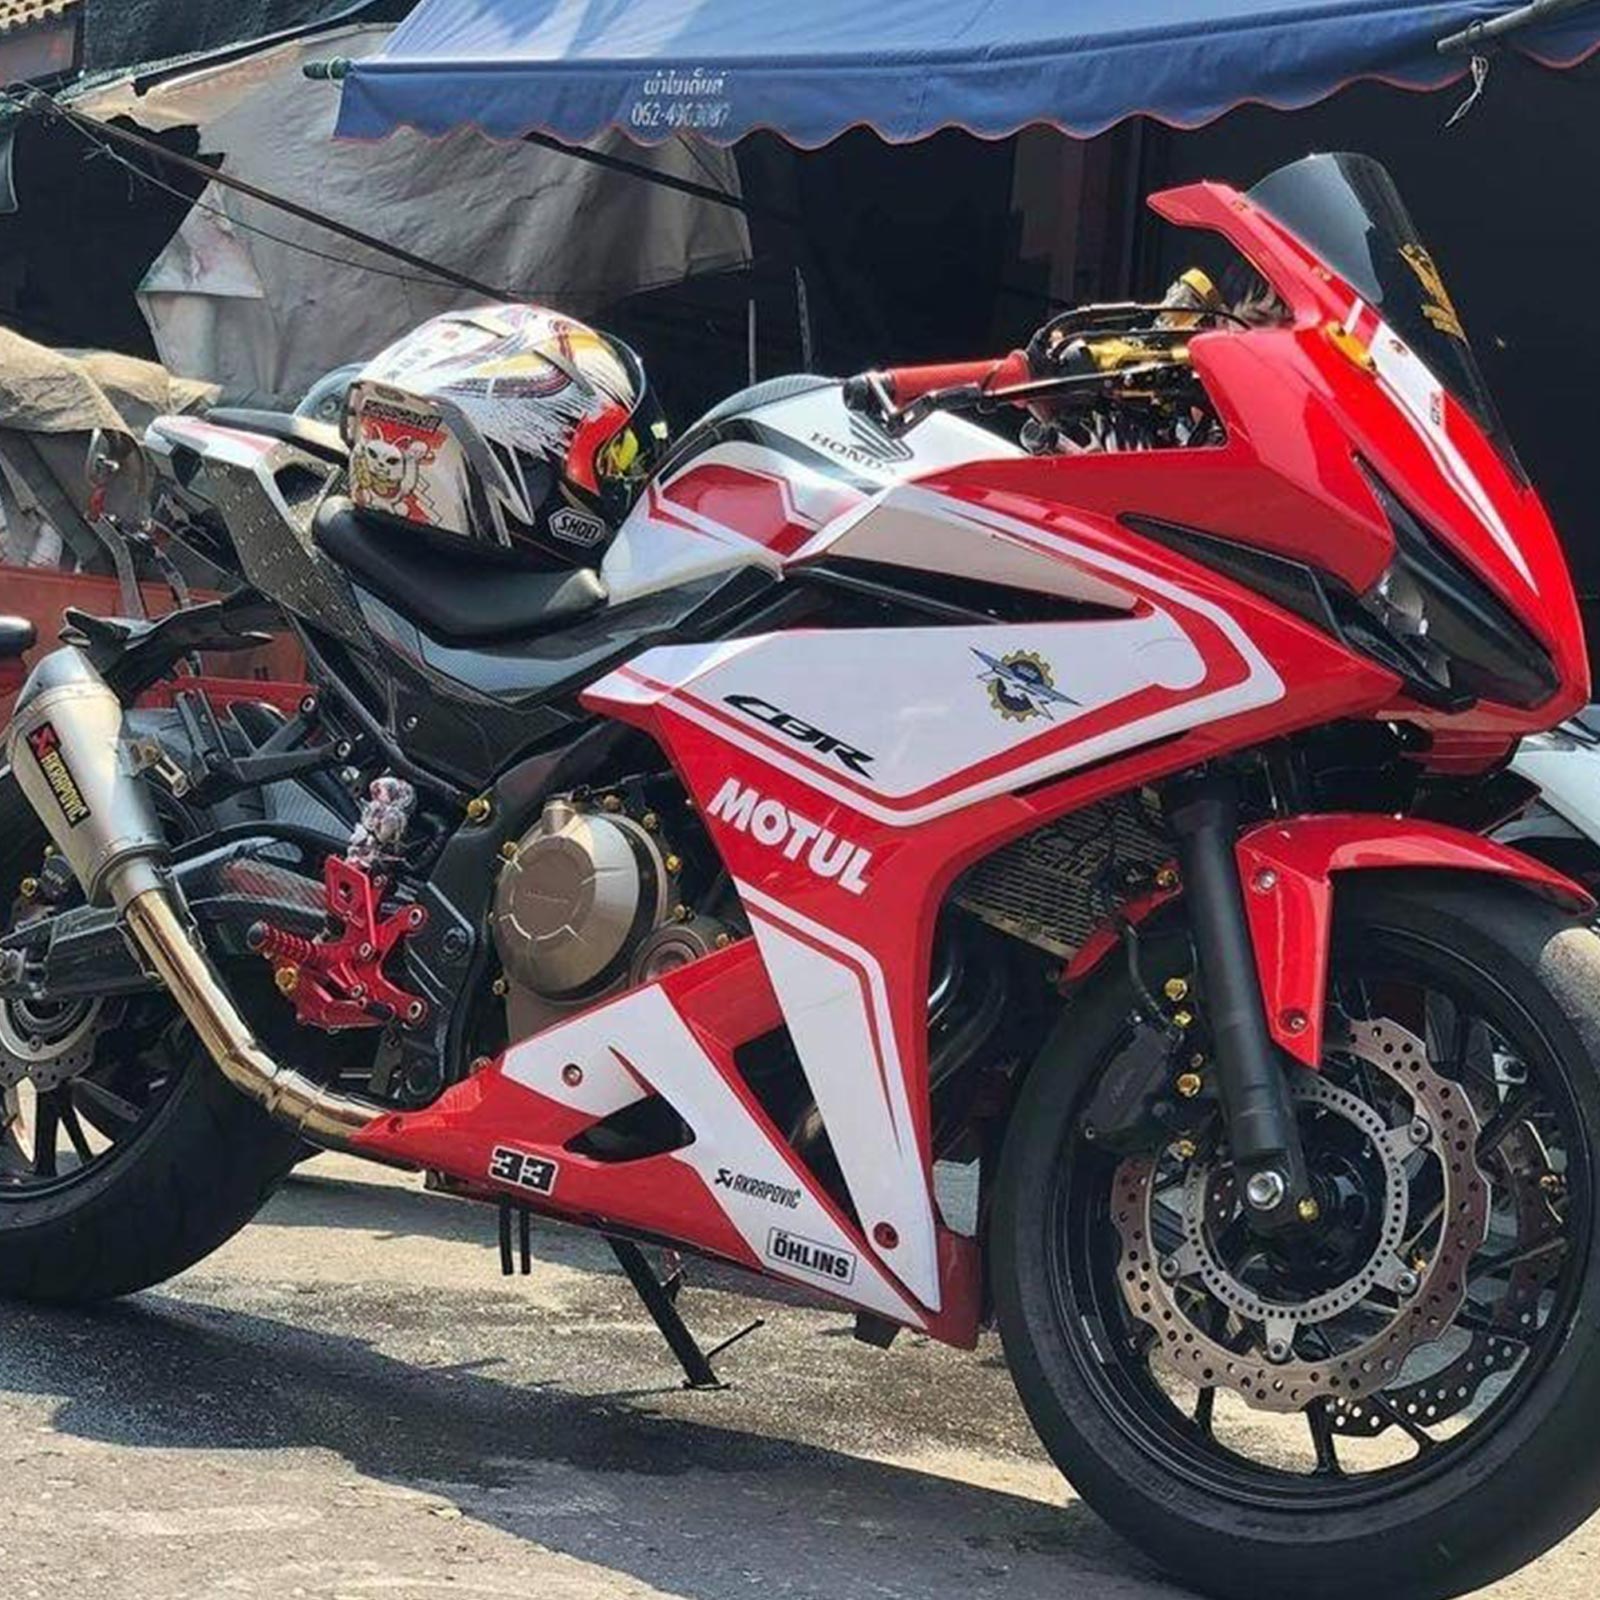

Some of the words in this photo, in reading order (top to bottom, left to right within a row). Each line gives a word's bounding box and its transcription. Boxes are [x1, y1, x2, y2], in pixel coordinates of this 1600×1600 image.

[722, 694, 876, 781] CBR
[705, 776, 873, 895] MOTUL
[491, 1147, 556, 1193] 33
[773, 1232, 850, 1279] ÖHLINS
